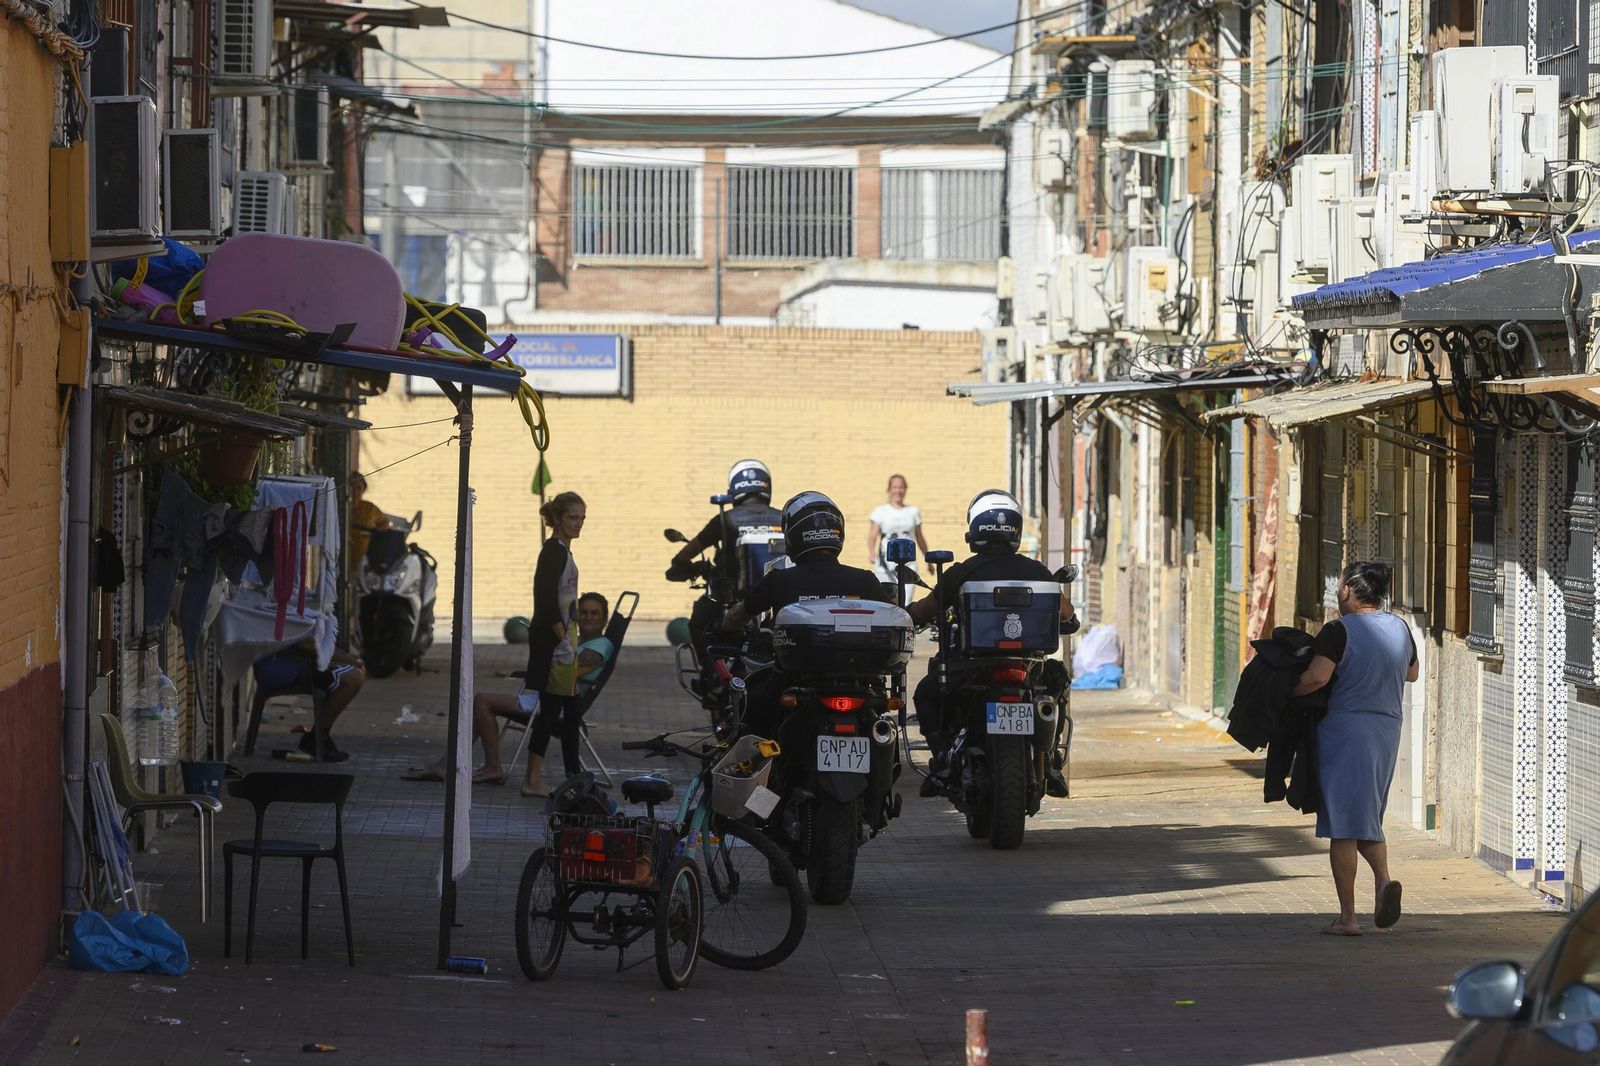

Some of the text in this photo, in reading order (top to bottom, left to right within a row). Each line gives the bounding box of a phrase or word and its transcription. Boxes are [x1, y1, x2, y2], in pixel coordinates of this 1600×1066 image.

[518, 354, 613, 366] TORREBLANCA
[734, 480, 765, 491] POLICIA
[802, 528, 836, 537] POLICIA
[978, 524, 1016, 533] POLICIA
[803, 534, 840, 543] NACIONAL
[998, 718, 1029, 732] 4181
[823, 753, 864, 769] 4117
